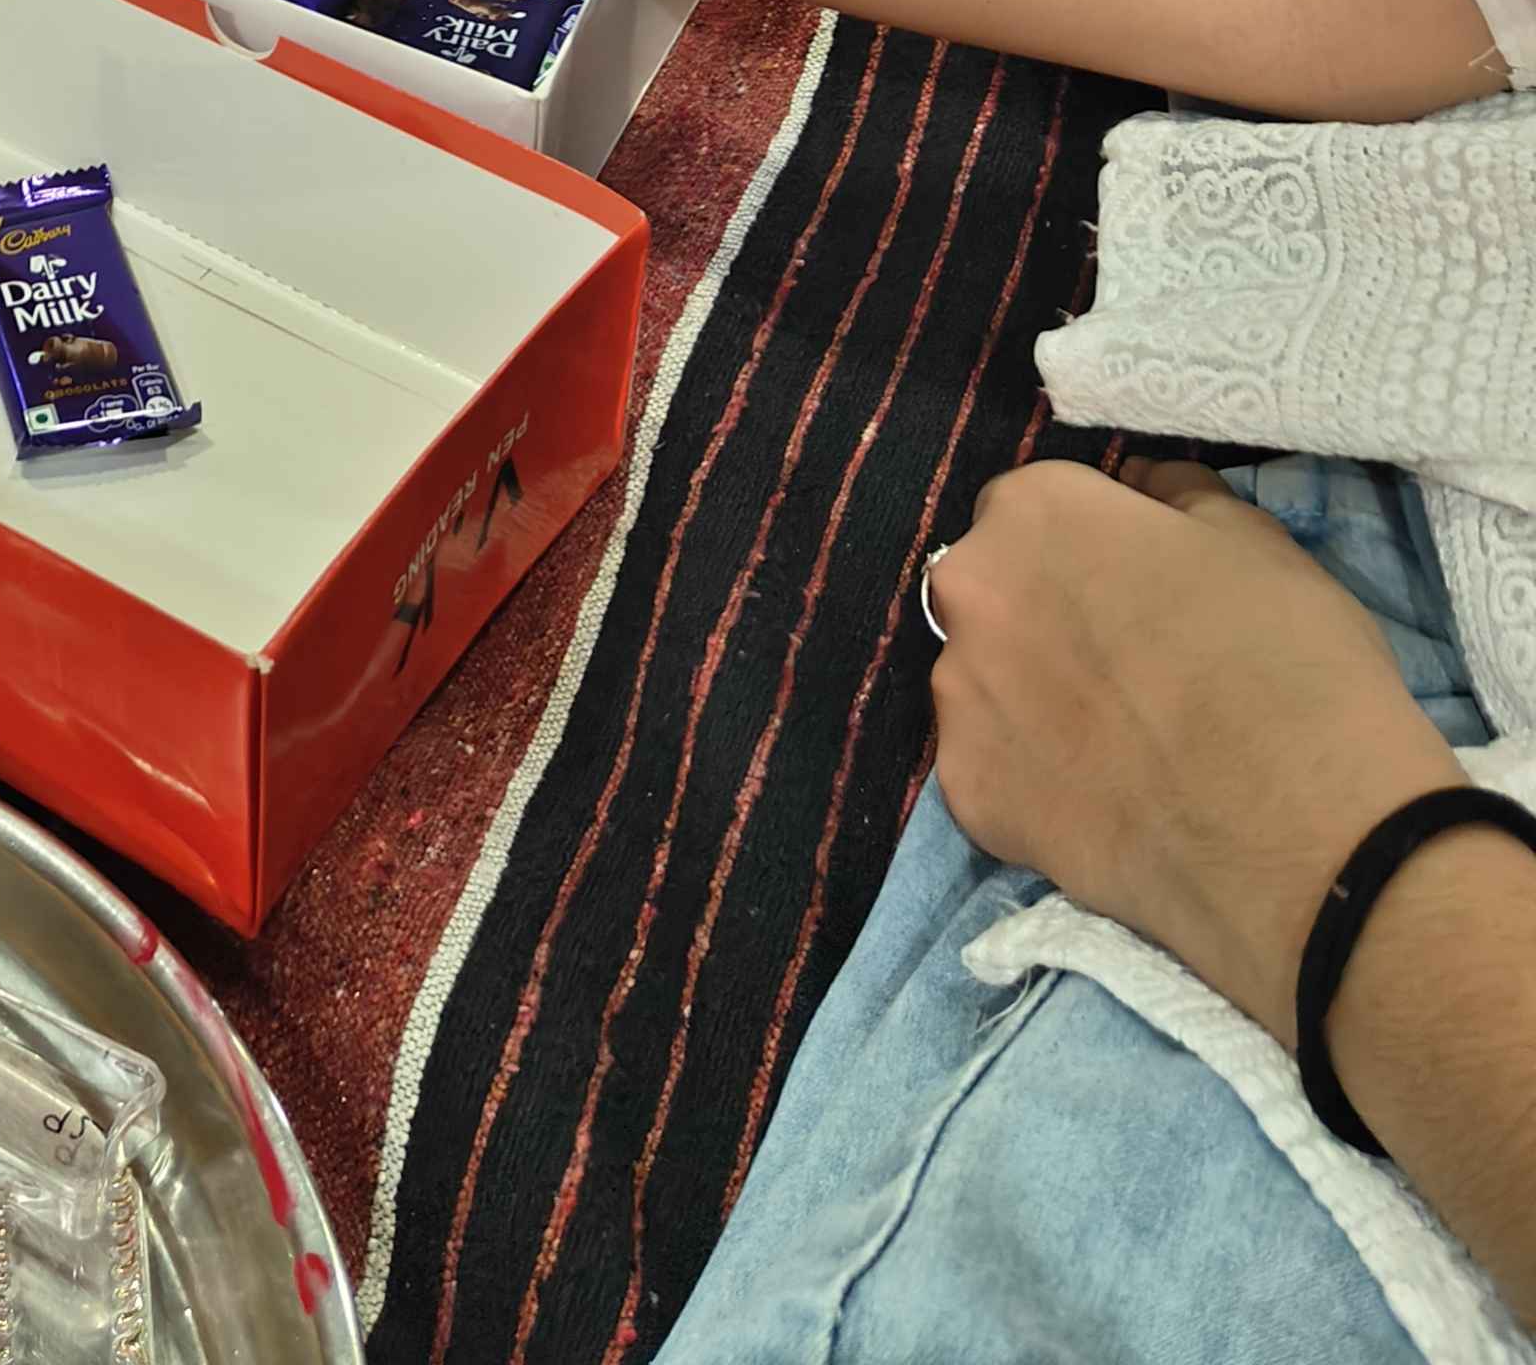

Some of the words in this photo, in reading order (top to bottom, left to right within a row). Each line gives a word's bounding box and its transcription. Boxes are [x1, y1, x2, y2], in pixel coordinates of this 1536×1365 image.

[423, 26, 518, 59] Dairy
[435, 15, 519, 43] Milk
[0, 224, 72, 255] Cadbury
[0, 271, 98, 308] Dairy
[13, 298, 105, 333] Milk
[487, 412, 529, 472] PEN
[393, 470, 478, 604] READING
